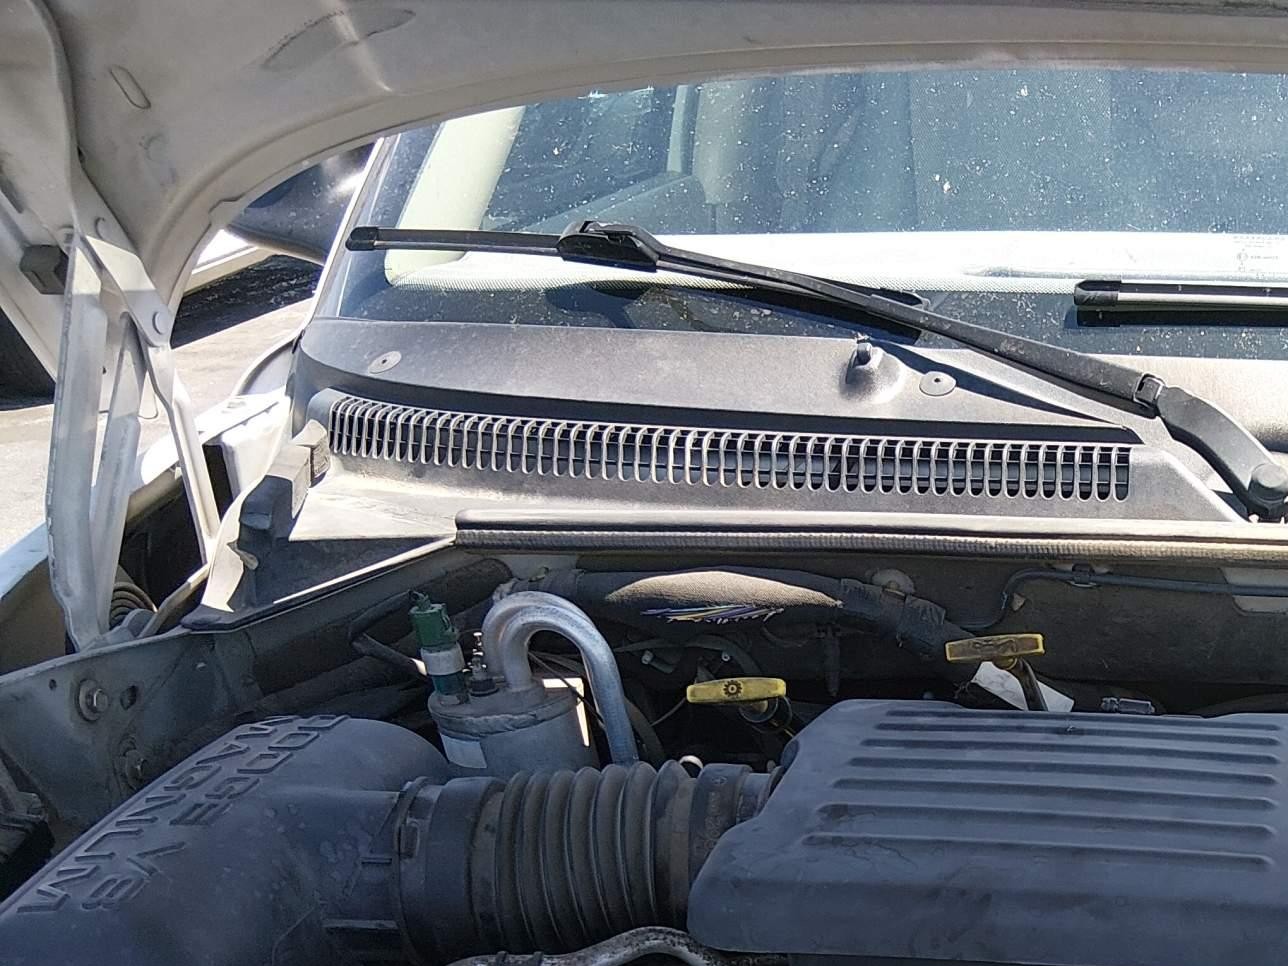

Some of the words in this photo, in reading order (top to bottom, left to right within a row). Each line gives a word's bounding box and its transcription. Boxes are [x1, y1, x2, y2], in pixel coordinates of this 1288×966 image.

[17, 715, 299, 913] MAGNUM
[169, 714, 348, 826] DODGE
[81, 841, 187, 912] V8
